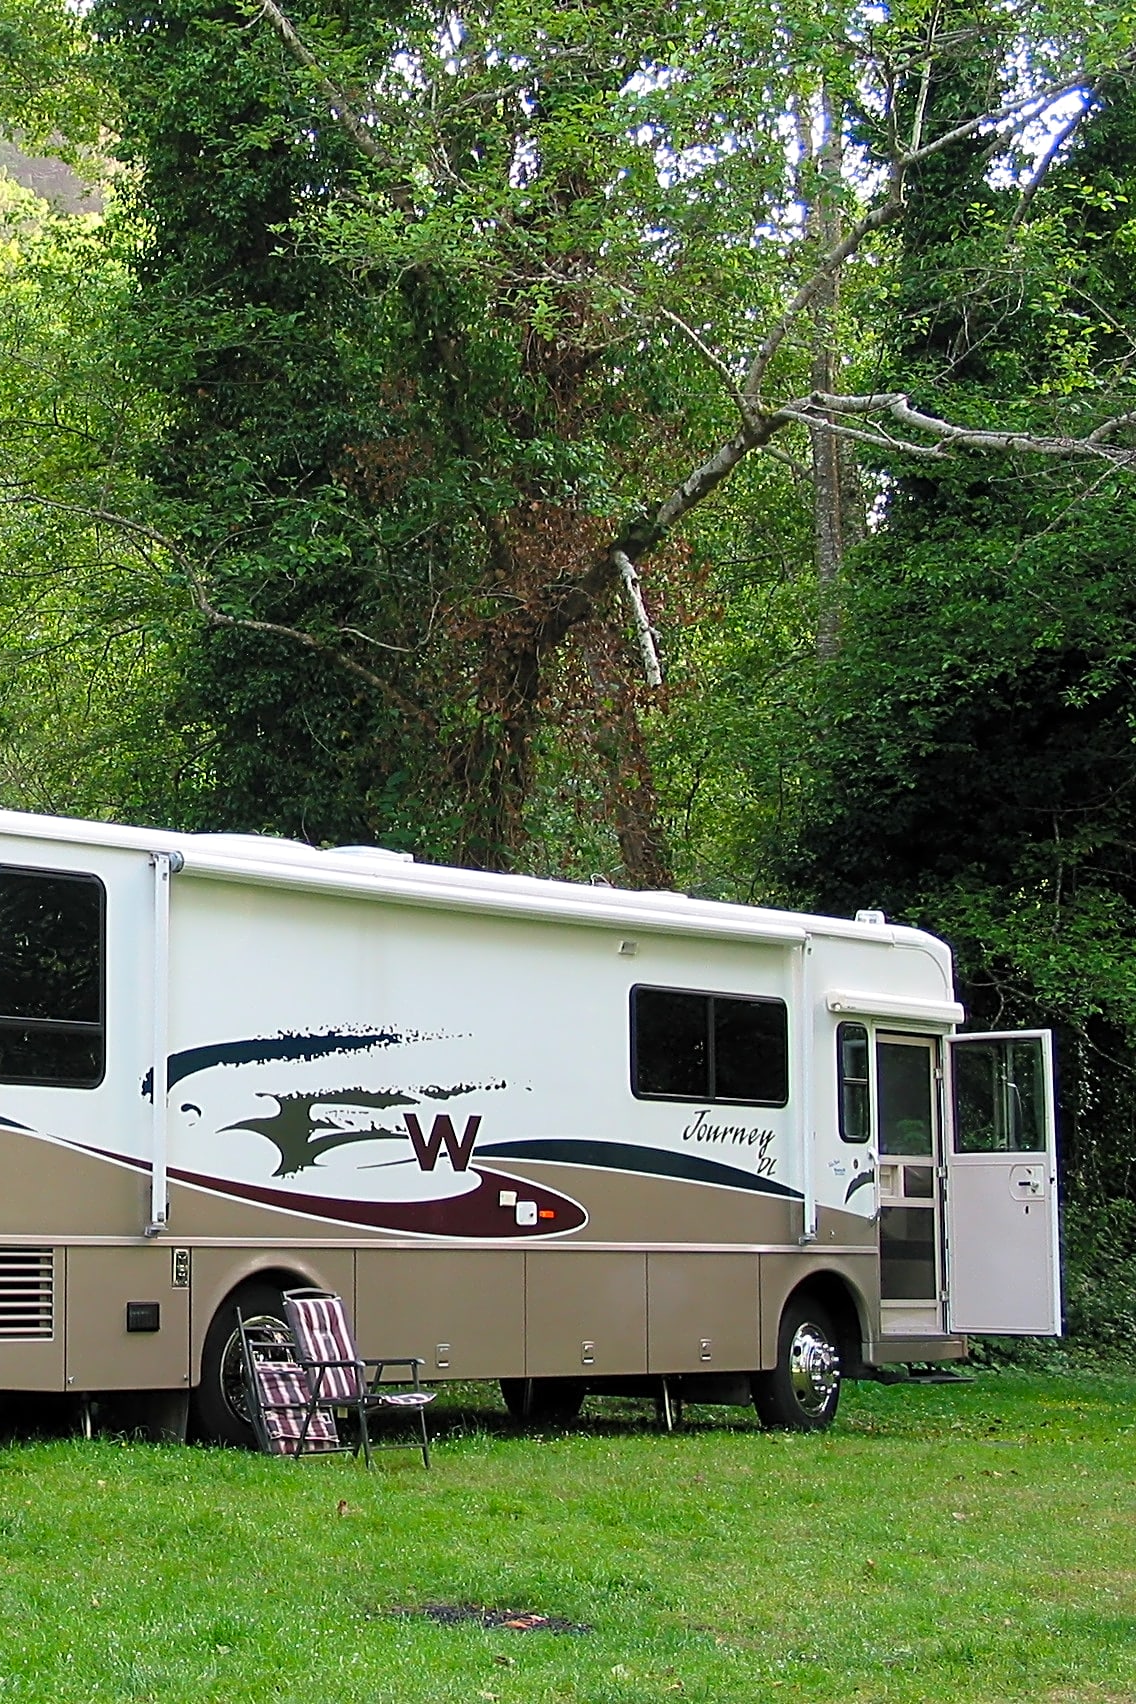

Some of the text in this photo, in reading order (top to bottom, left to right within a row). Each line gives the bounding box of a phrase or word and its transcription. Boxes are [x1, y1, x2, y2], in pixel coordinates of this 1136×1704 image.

[403, 1112, 482, 1173] W
[682, 1109, 776, 1160] Journey
[756, 1156, 778, 1177] DL
